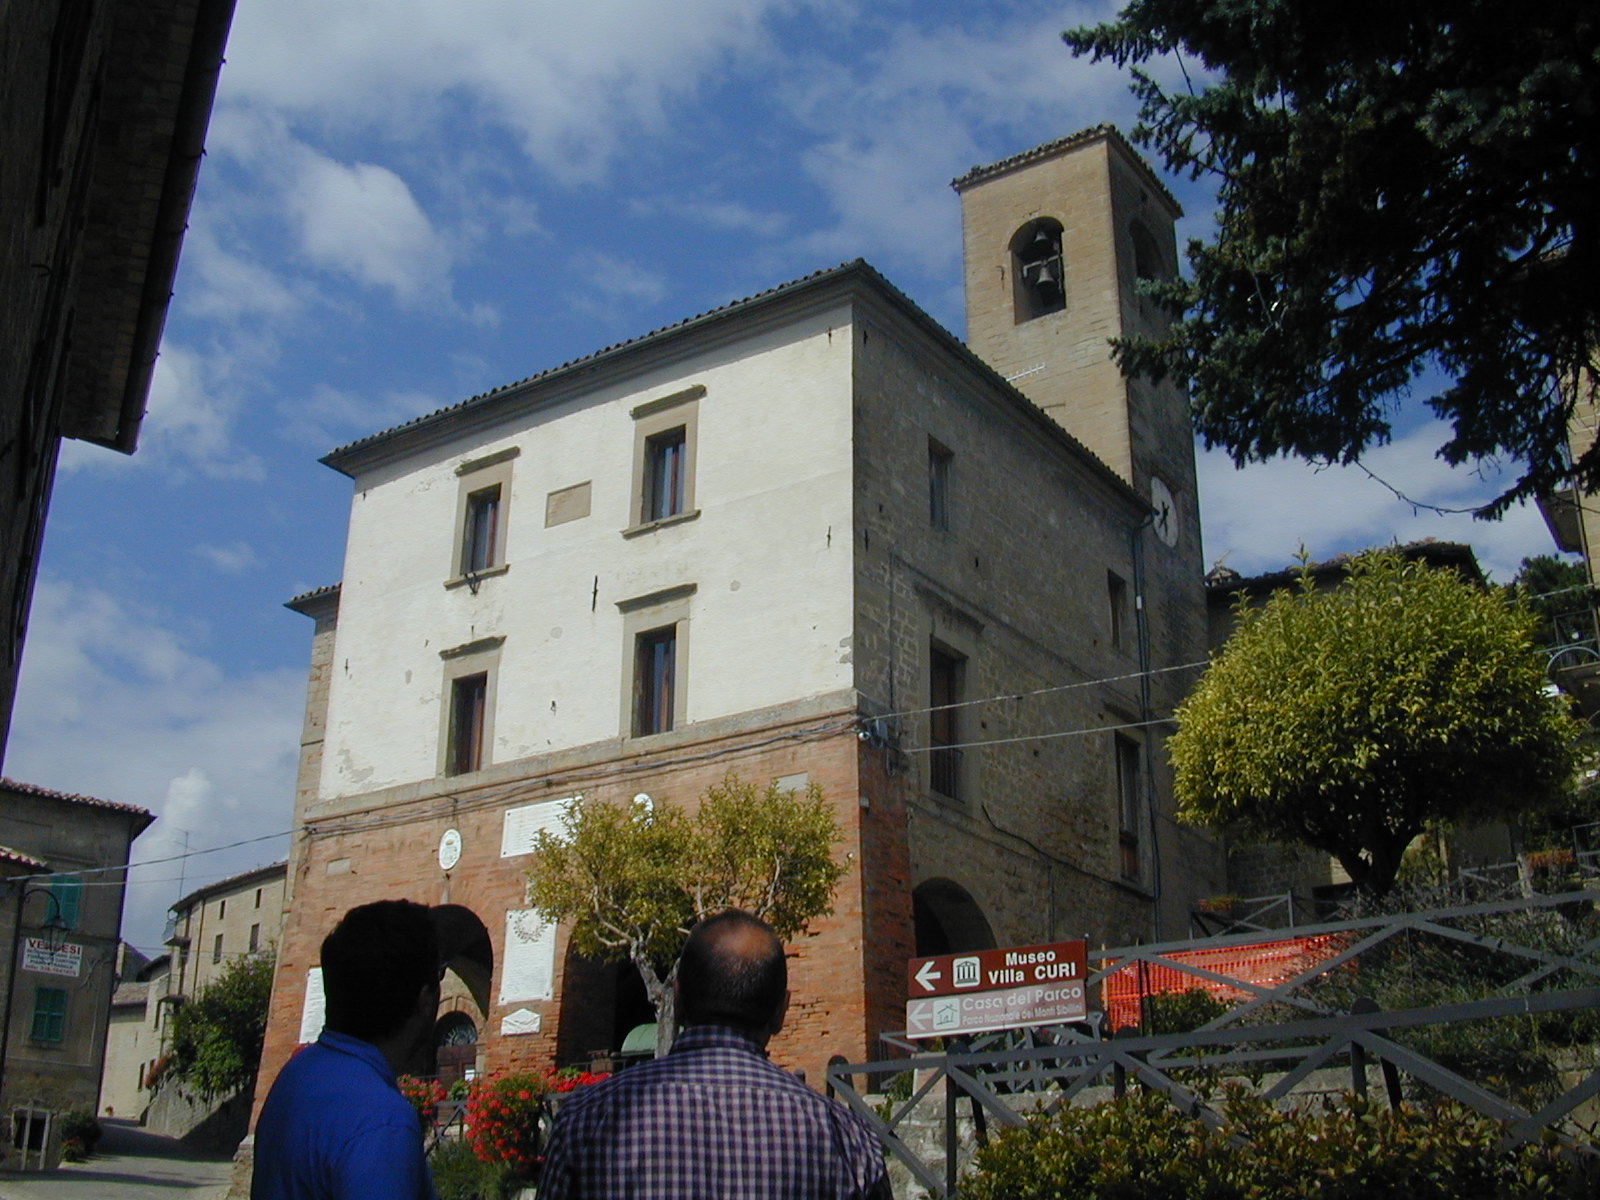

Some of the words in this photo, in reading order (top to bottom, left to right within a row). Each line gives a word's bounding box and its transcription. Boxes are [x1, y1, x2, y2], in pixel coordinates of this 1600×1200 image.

[1005, 951, 1056, 966] Museo
[988, 968, 1025, 985] Villa
[1034, 962, 1076, 979] CURI
[962, 997, 1003, 1011] Casa
[1006, 992, 1031, 1007] del
[1034, 987, 1082, 1002] Parco
[962, 1014, 984, 1026] Parco
[1034, 1005, 1056, 1018] Monti
